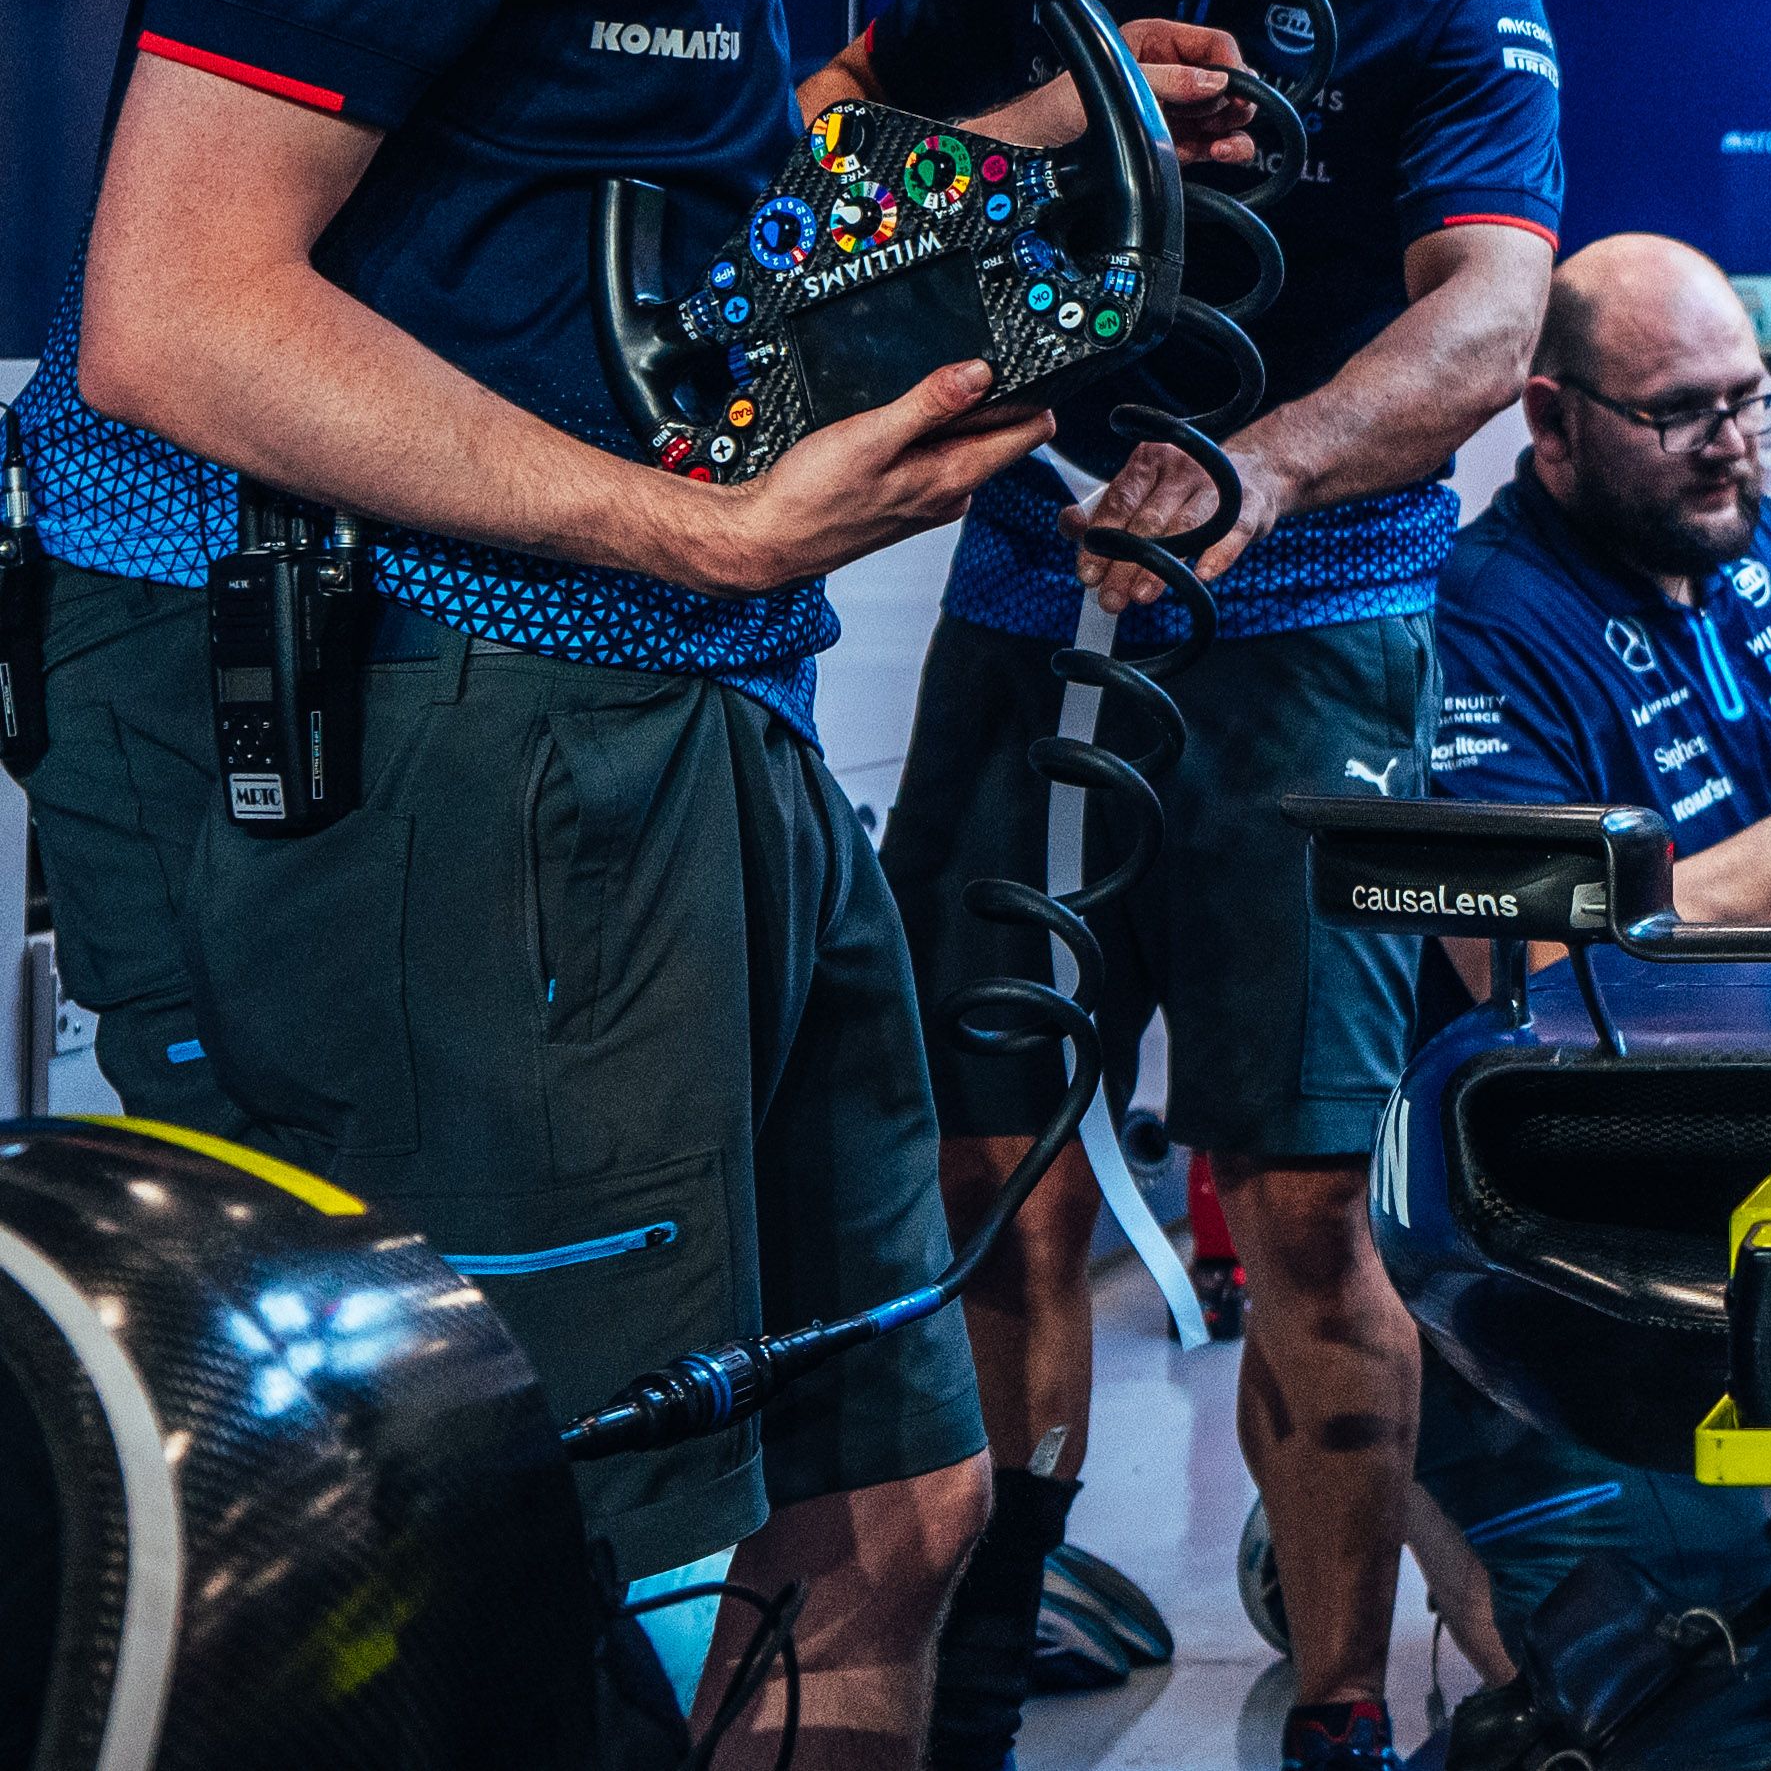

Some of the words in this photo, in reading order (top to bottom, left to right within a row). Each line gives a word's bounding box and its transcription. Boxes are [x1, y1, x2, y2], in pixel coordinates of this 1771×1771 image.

[590, 20, 741, 61] KOMATSU
[840, 164, 871, 185] TYRE
[803, 230, 943, 298] WILLIAMS
[1109, 255, 1130, 266] ENT
[713, 265, 737, 283] HPP
[1032, 289, 1050, 305] OK
[730, 406, 754, 422] RAD
[652, 428, 672, 448] MID
[1443, 694, 1506, 712] ENUITY
[1430, 755, 1479, 771] entures
[1352, 885, 1519, 917] causaLens
